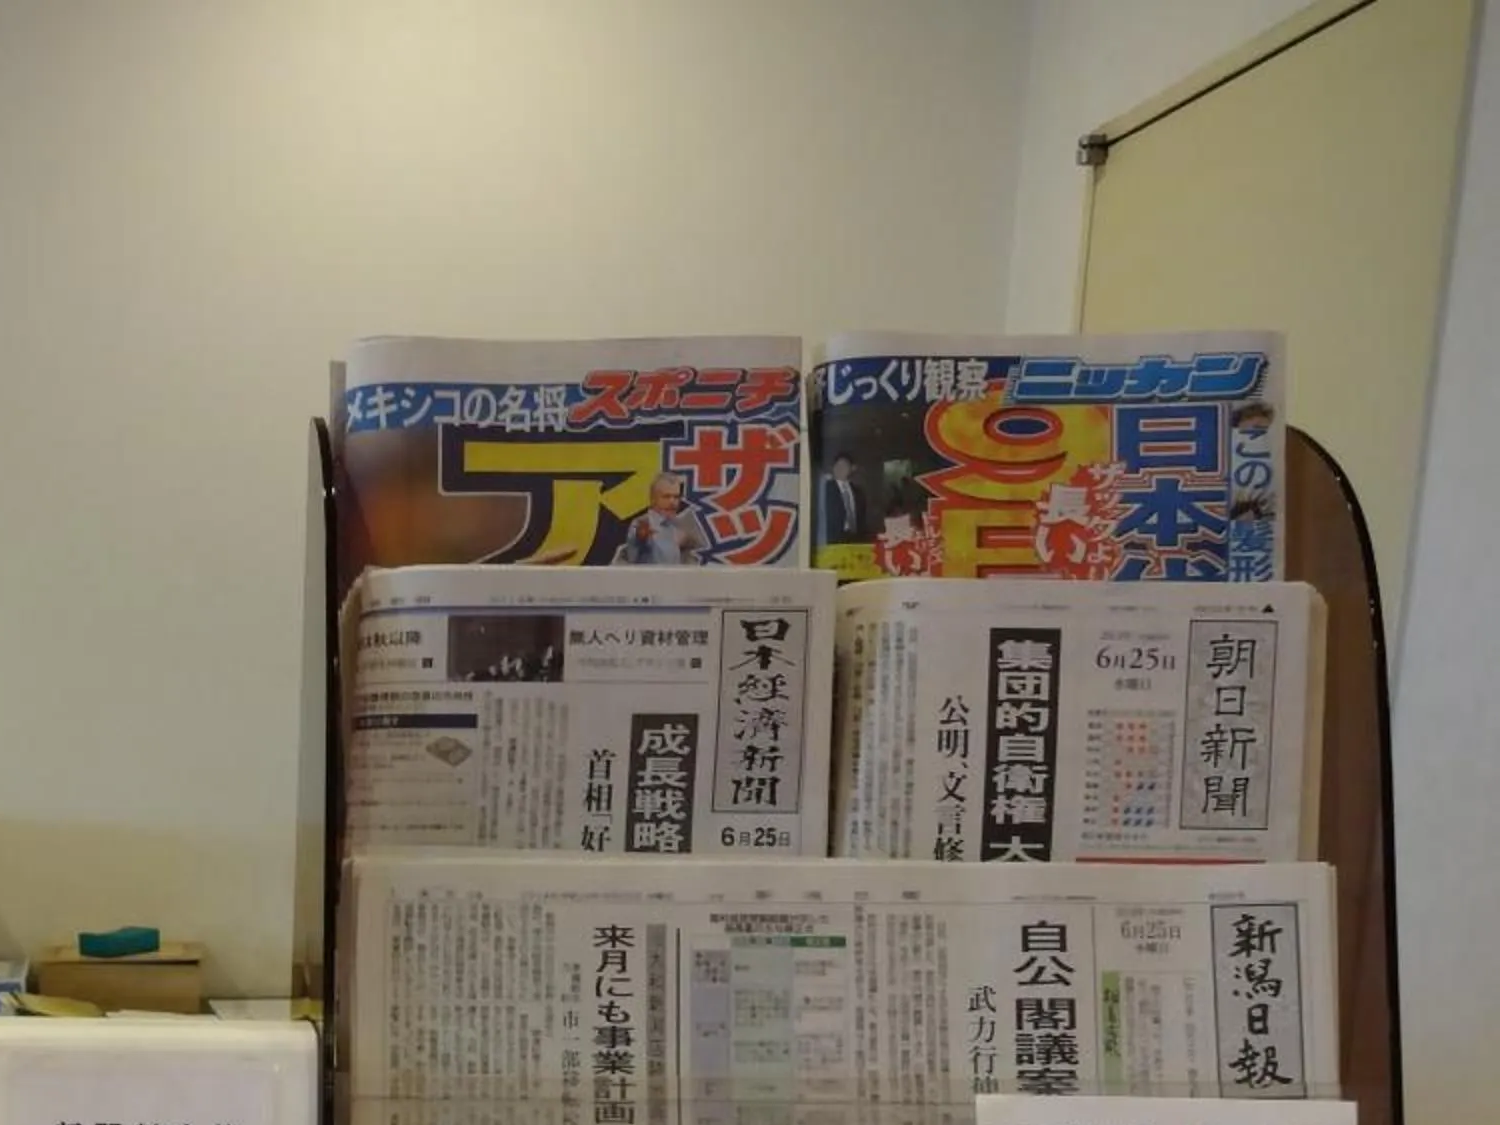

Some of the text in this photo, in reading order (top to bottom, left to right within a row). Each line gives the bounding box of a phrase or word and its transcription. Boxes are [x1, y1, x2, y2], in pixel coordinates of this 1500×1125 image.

[567, 368, 797, 422] スポニチ
[1013, 355, 1264, 400] ニッカン
[346, 385, 568, 433] メキシコの名将
[569, 629, 709, 647] 無人ヘリ資材管理
[1095, 646, 1176, 670] 6月25日
[1200, 633, 1258, 817] 朝日新聞
[632, 723, 691, 852] 成長戦略
[721, 826, 791, 848] 6月25日
[1228, 913, 1293, 1090] 新潟日報
